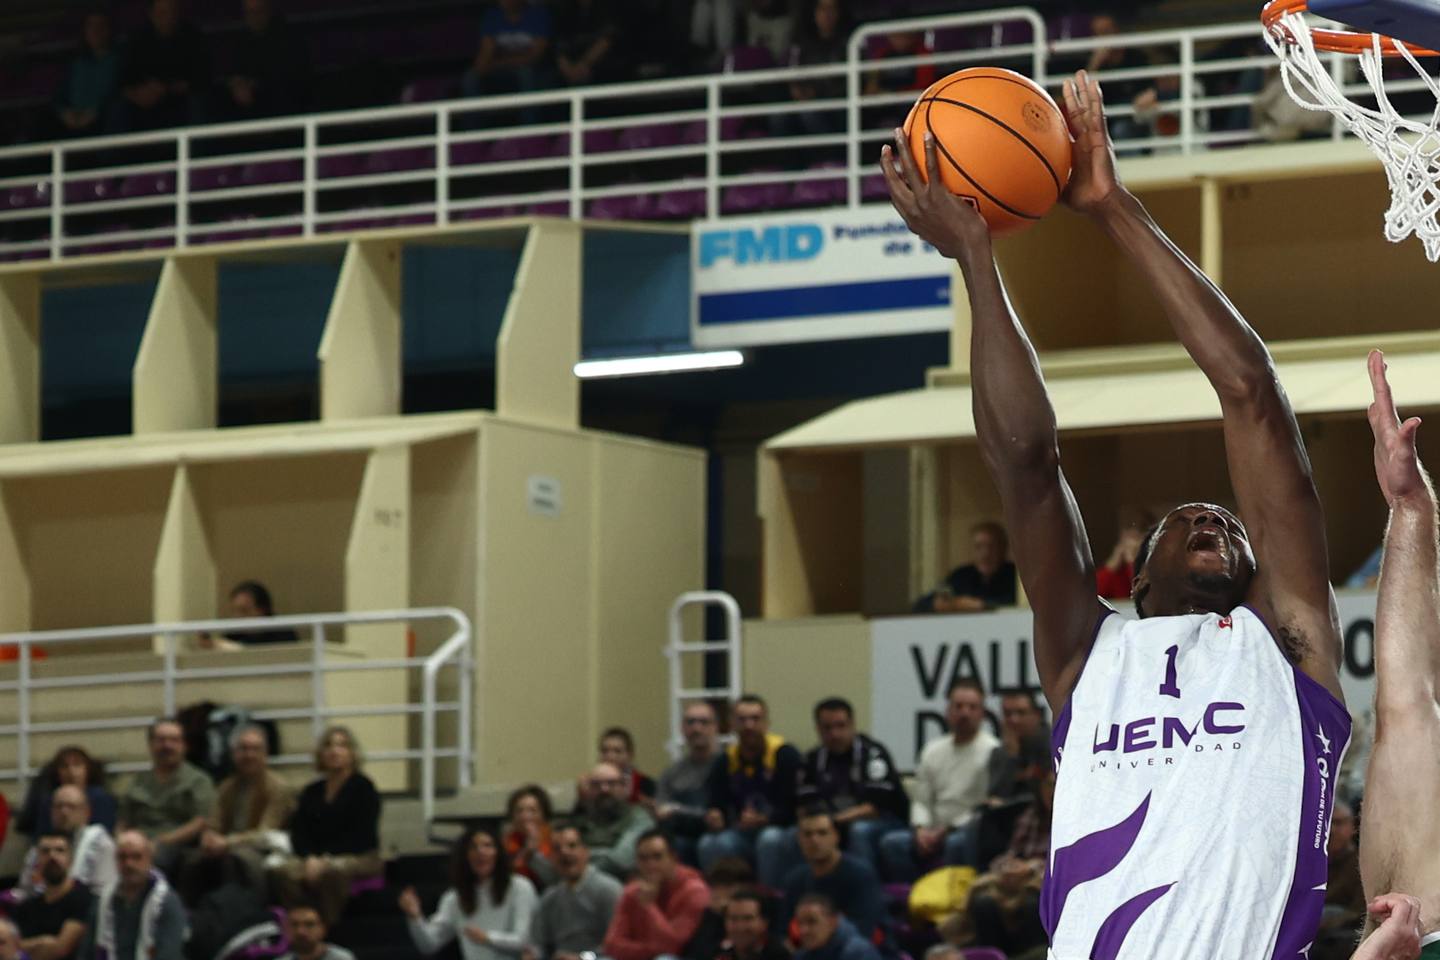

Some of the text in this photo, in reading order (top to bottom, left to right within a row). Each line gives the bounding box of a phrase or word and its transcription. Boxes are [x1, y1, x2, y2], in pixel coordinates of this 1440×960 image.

[697, 223, 824, 268] FMD
[911, 640, 1044, 698] VALL
[1159, 644, 1181, 698] 1
